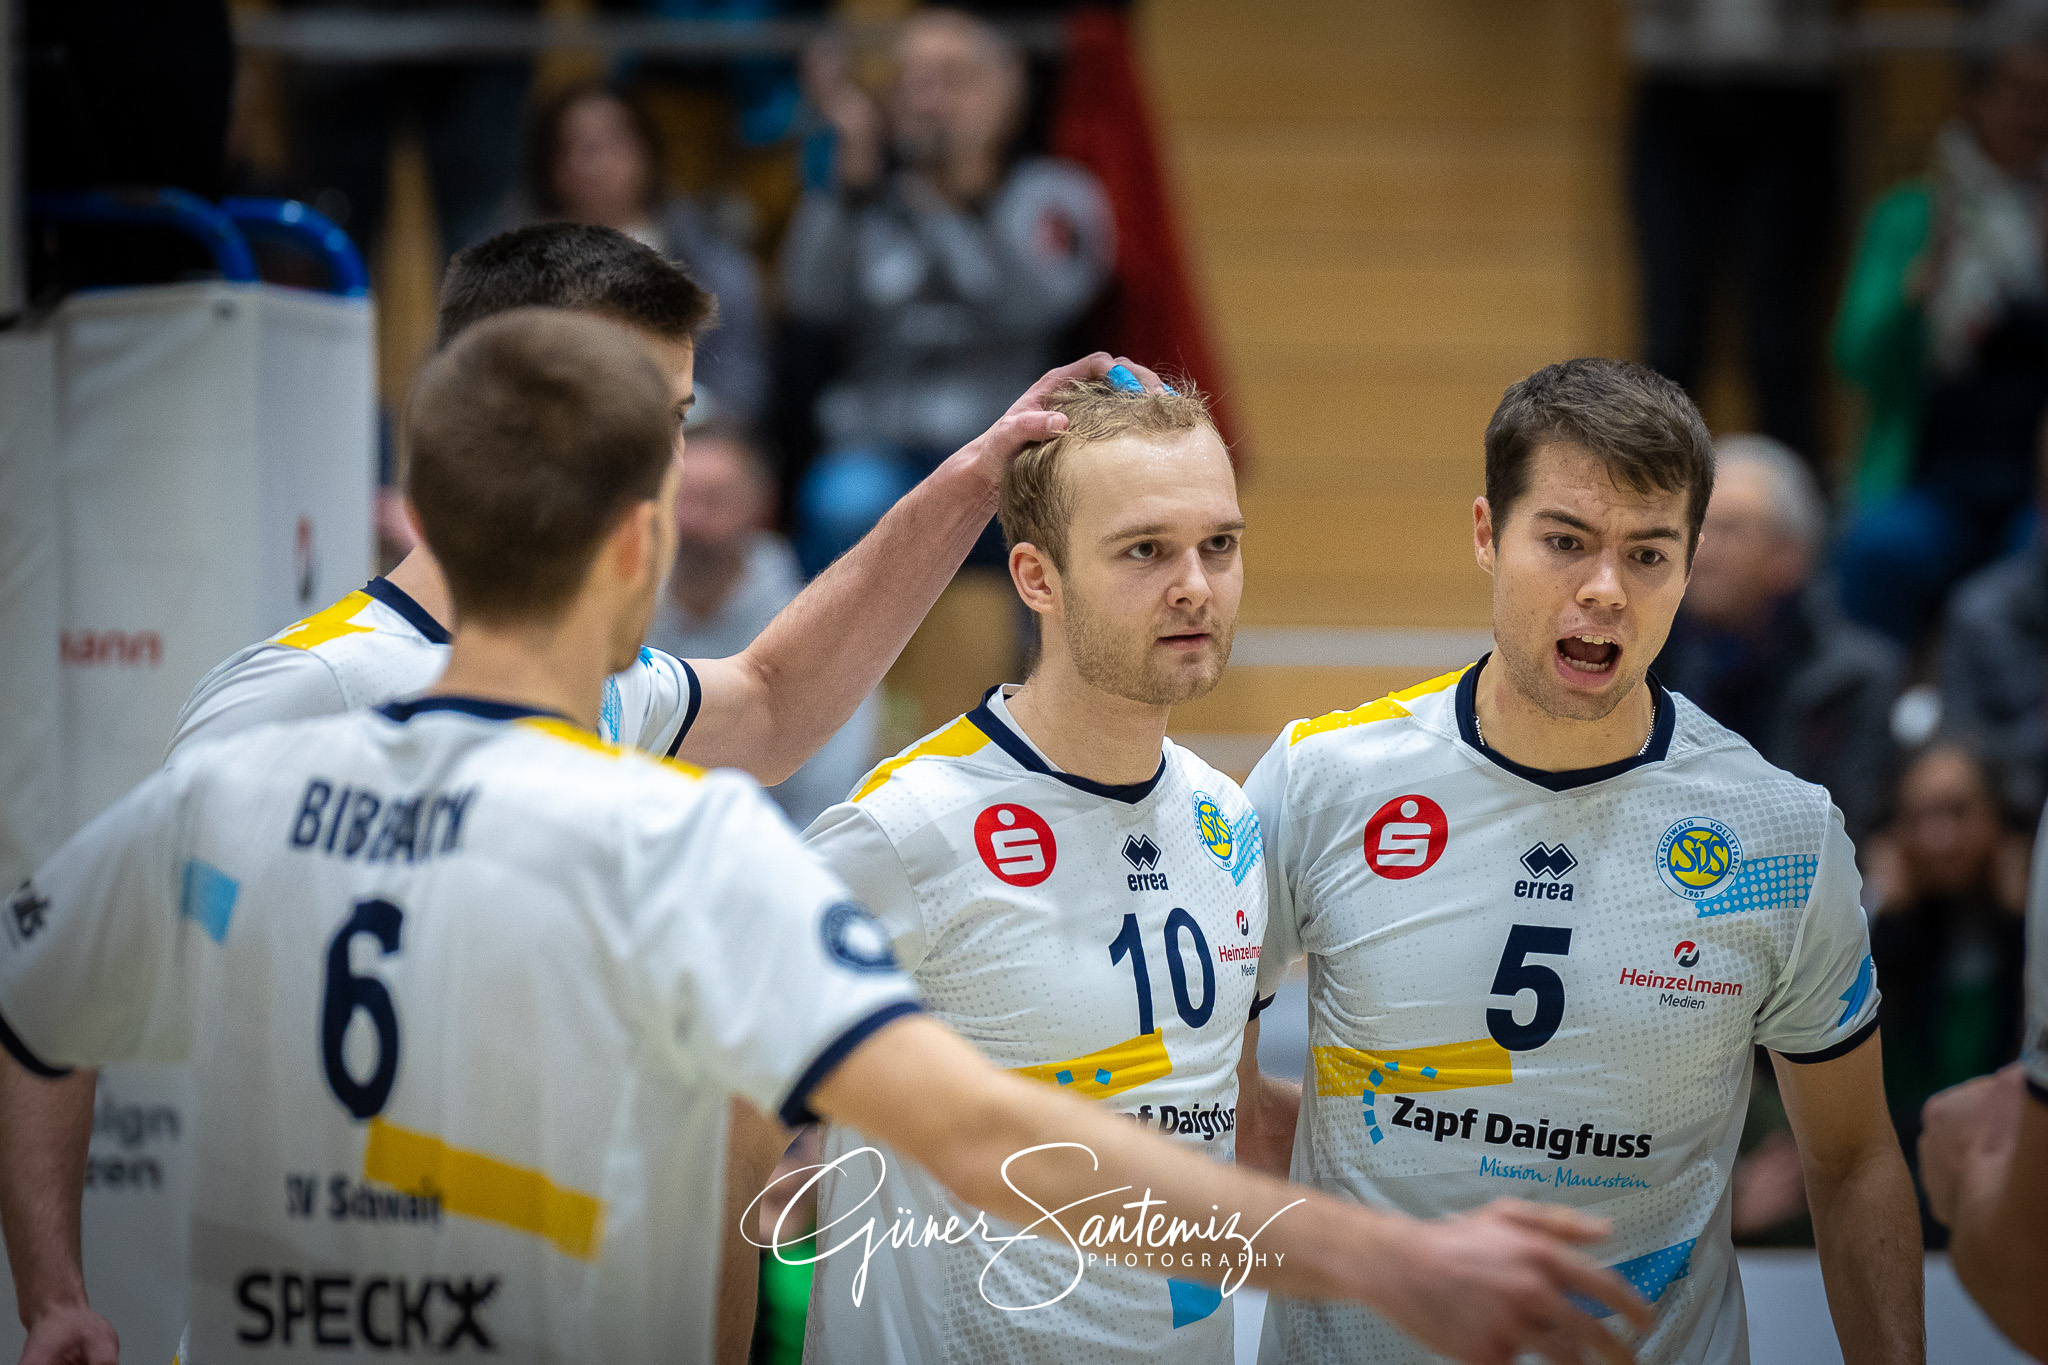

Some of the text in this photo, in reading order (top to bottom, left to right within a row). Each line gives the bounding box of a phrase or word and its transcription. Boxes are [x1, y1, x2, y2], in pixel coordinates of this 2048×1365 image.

[1659, 820, 1740, 876] SV SCHWAIG VOLLEYBALL
[1127, 872, 1169, 892] errea
[1514, 879, 1574, 901] errea
[1683, 888, 1705, 899] 1967
[1108, 907, 1216, 1036] 10
[1619, 967, 1743, 997] Heinzelmann
[1485, 923, 1573, 1052] 5
[1659, 993, 1705, 1010] Medien
[322, 899, 404, 1118] 6
[1391, 1095, 1652, 1161] Zapf Daigfuss
[1554, 1166, 1651, 1189] Mauerstein
